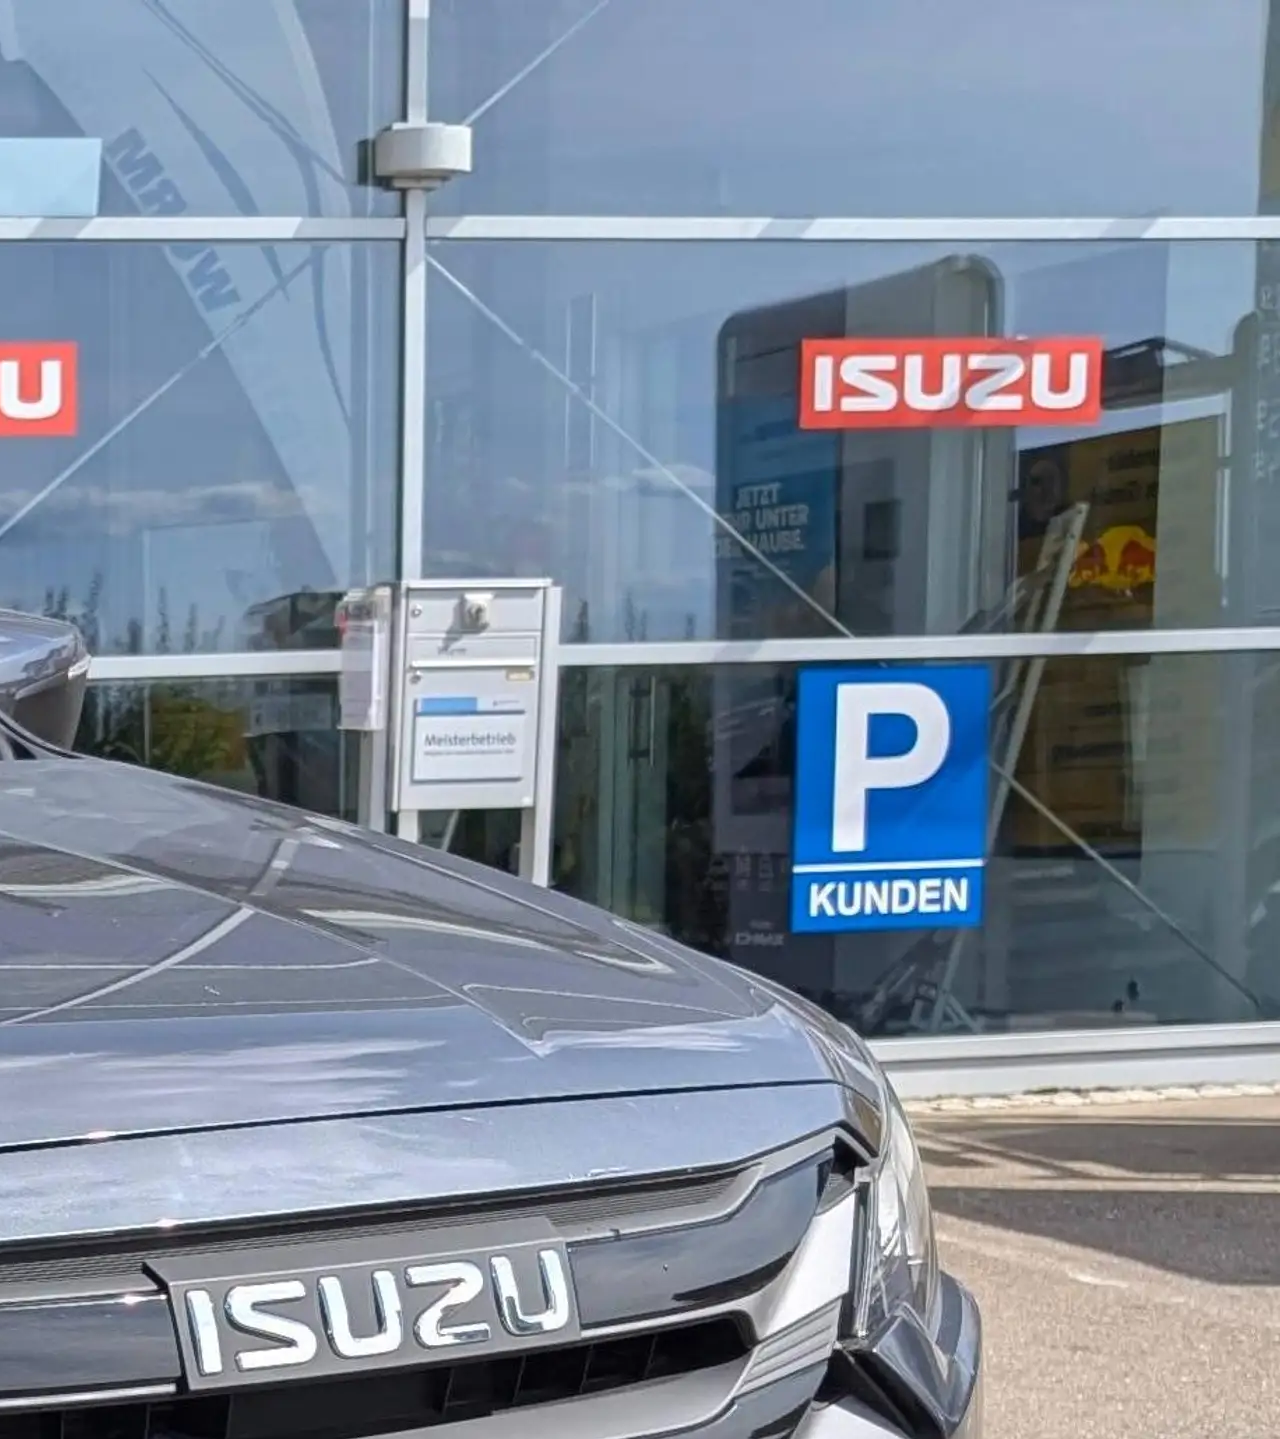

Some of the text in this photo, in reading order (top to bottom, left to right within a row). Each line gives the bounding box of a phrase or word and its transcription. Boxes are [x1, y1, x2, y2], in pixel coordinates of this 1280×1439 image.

[814, 353, 1088, 412] ISUZU
[755, 504, 809, 530] UNTER
[424, 732, 516, 747] Meisterbetrieb
[832, 682, 950, 852] P
[809, 878, 968, 917] KUNDEN
[186, 1249, 569, 1375] ISUZU
